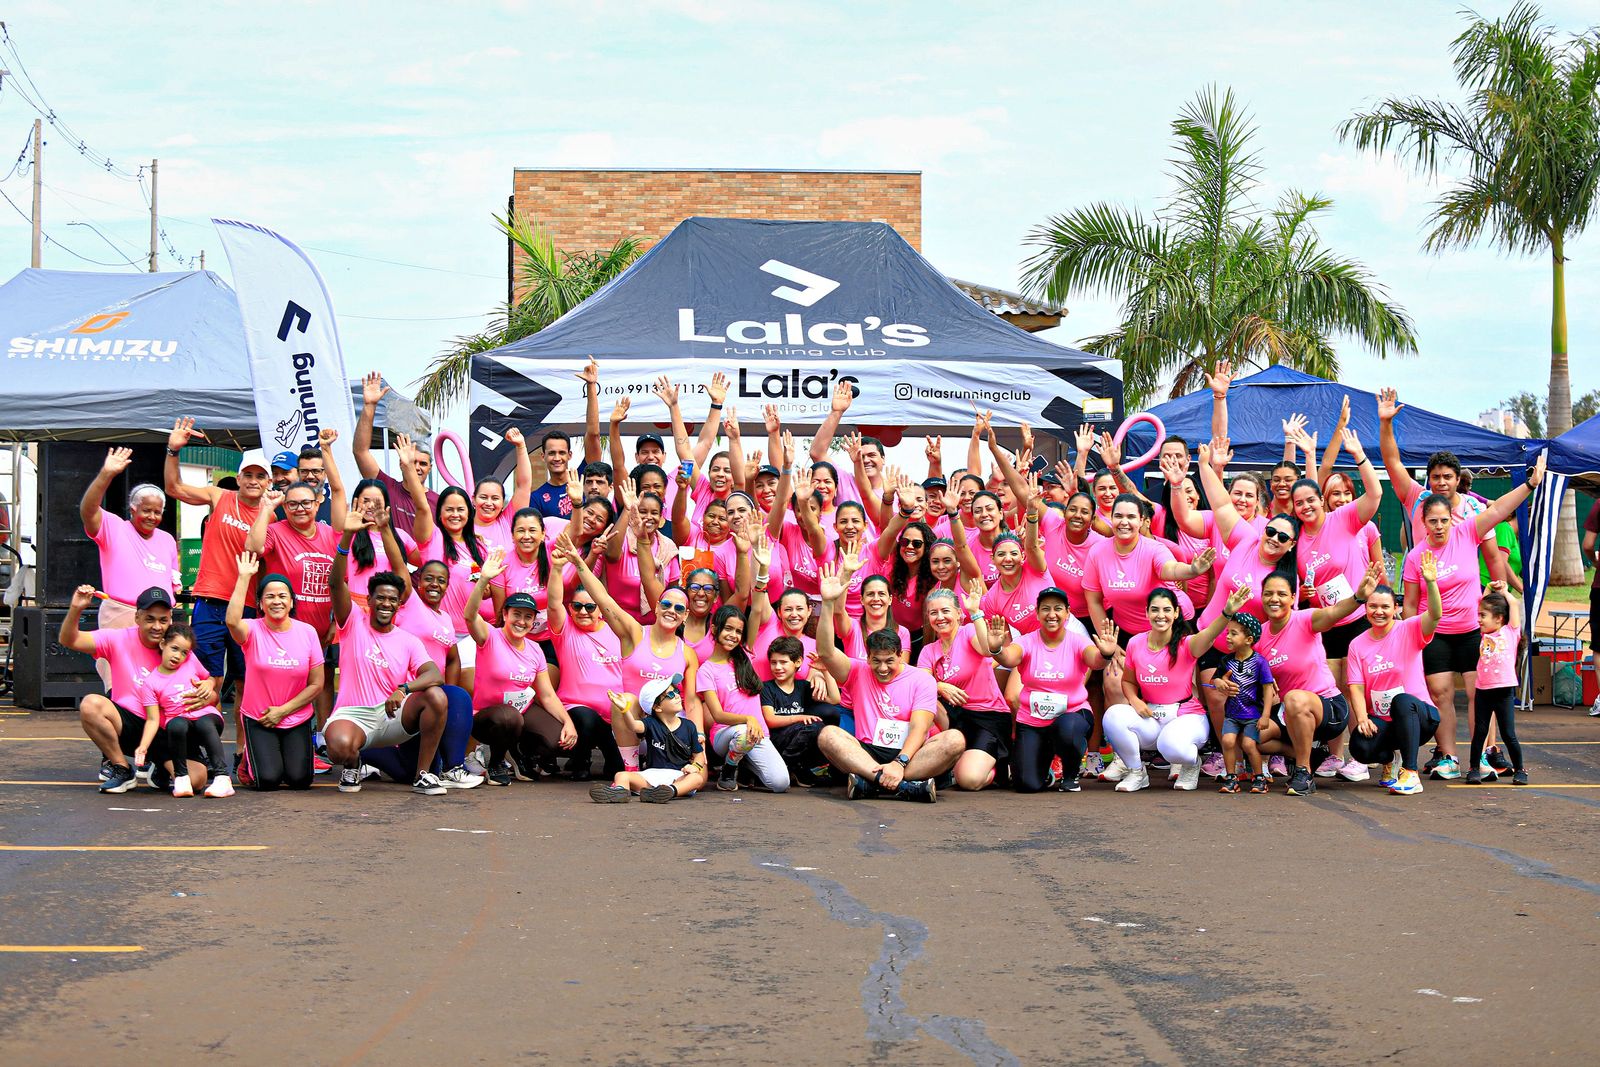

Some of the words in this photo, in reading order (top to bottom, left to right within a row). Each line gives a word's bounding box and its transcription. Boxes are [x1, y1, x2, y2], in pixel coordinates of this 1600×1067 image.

[678, 308, 931, 347] Lala's
[8, 337, 178, 357] SHIMIZU
[724, 347, 823, 356] running
[831, 348, 886, 356] club
[738, 367, 861, 399] Lala's
[604, 386, 624, 395] (16)
[917, 387, 1031, 402] lalasrunningclub
[760, 402, 807, 413] rning
[811, 402, 834, 412] clu
[1056, 558, 1084, 577] Lala's
[516, 584, 545, 594] Lala'
[1108, 579, 1136, 588] Lala's
[1009, 604, 1036, 622] Lala's
[268, 655, 299, 666] Lala's
[365, 649, 389, 668] Laa's
[1268, 654, 1289, 666] ala's
[943, 665, 960, 680] ala's
[1367, 661, 1394, 674] Lala's
[640, 669, 671, 681] Lala'
[1034, 670, 1065, 679] Lala's
[1140, 673, 1169, 683] Lala's
[885, 732, 901, 740] 0011
